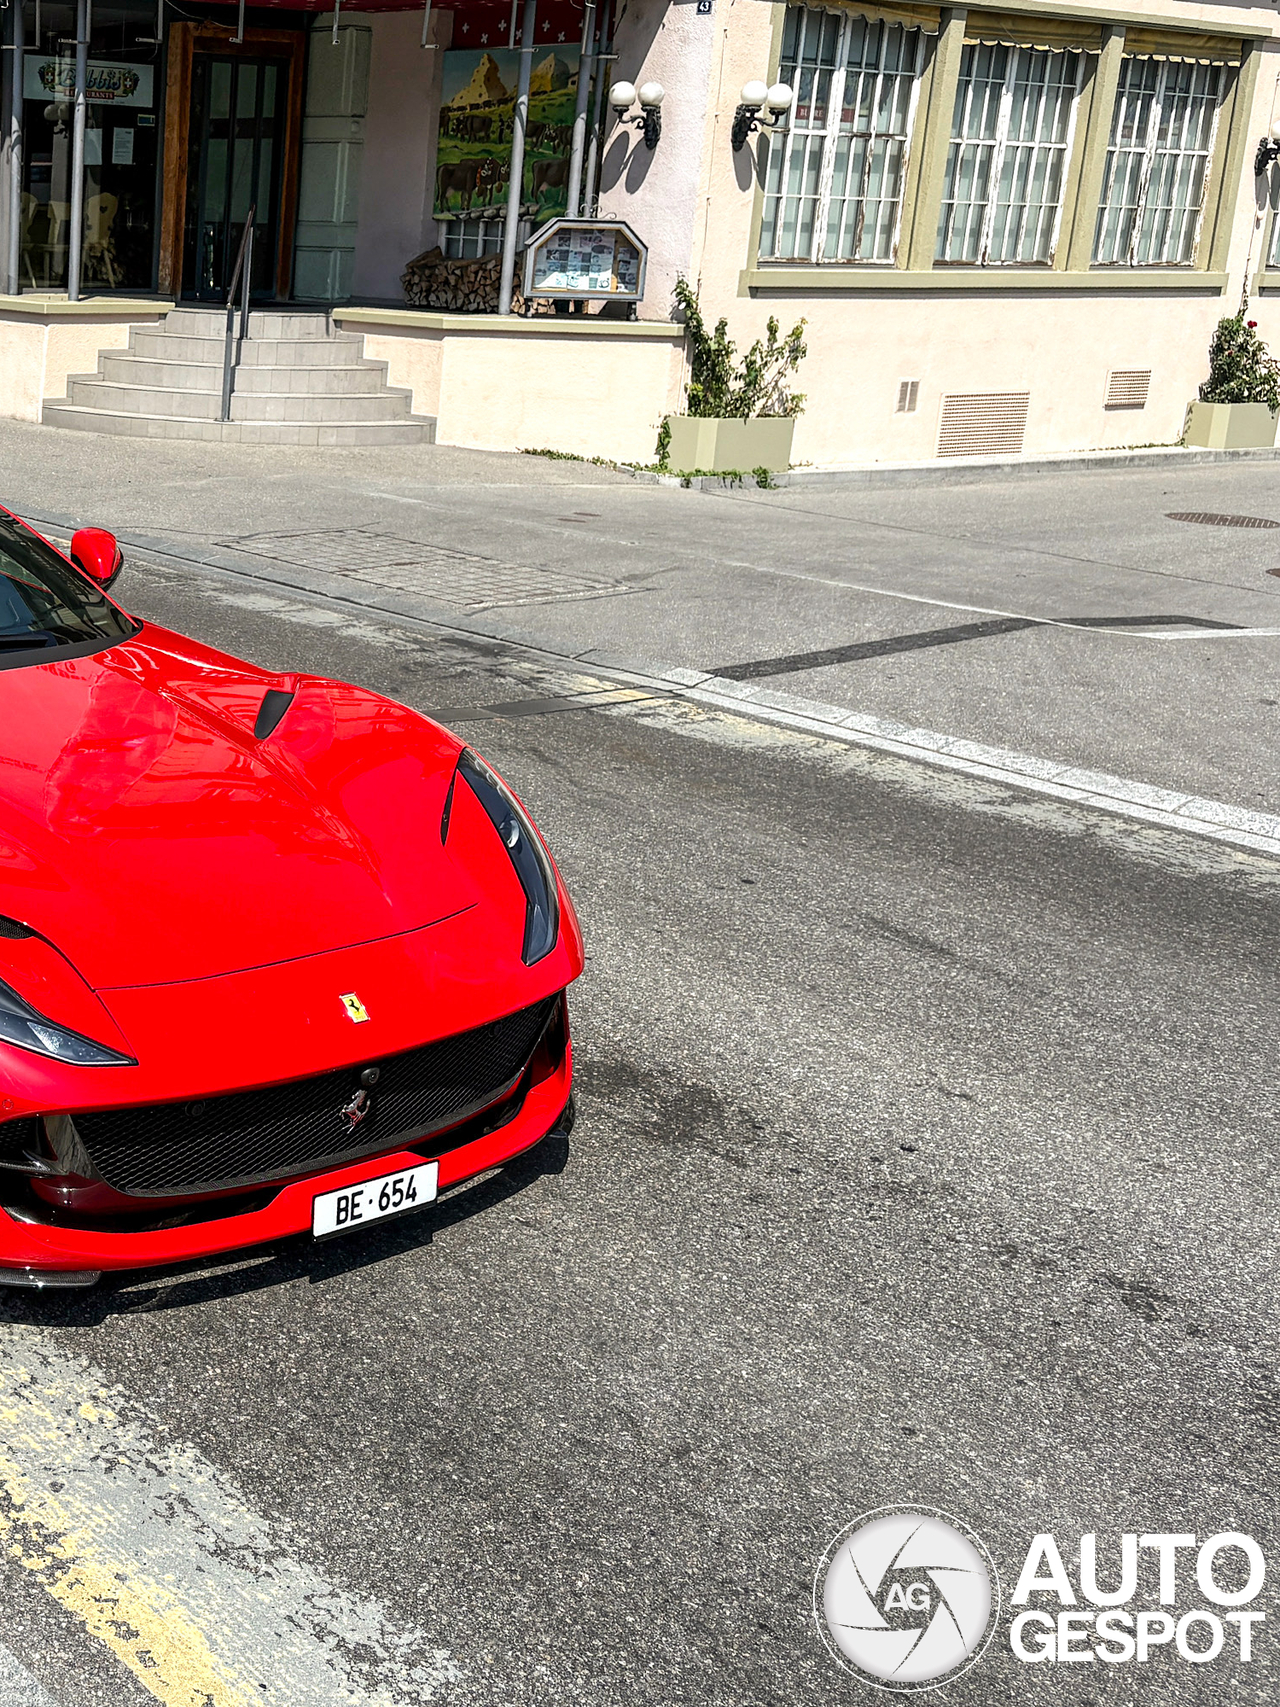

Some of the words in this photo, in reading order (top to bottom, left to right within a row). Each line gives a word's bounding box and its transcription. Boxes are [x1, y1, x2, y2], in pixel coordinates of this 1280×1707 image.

[699, 1, 710, 12] 43
[59, 68, 122, 90] Bbbis
[65, 89, 114, 99] REURANTS
